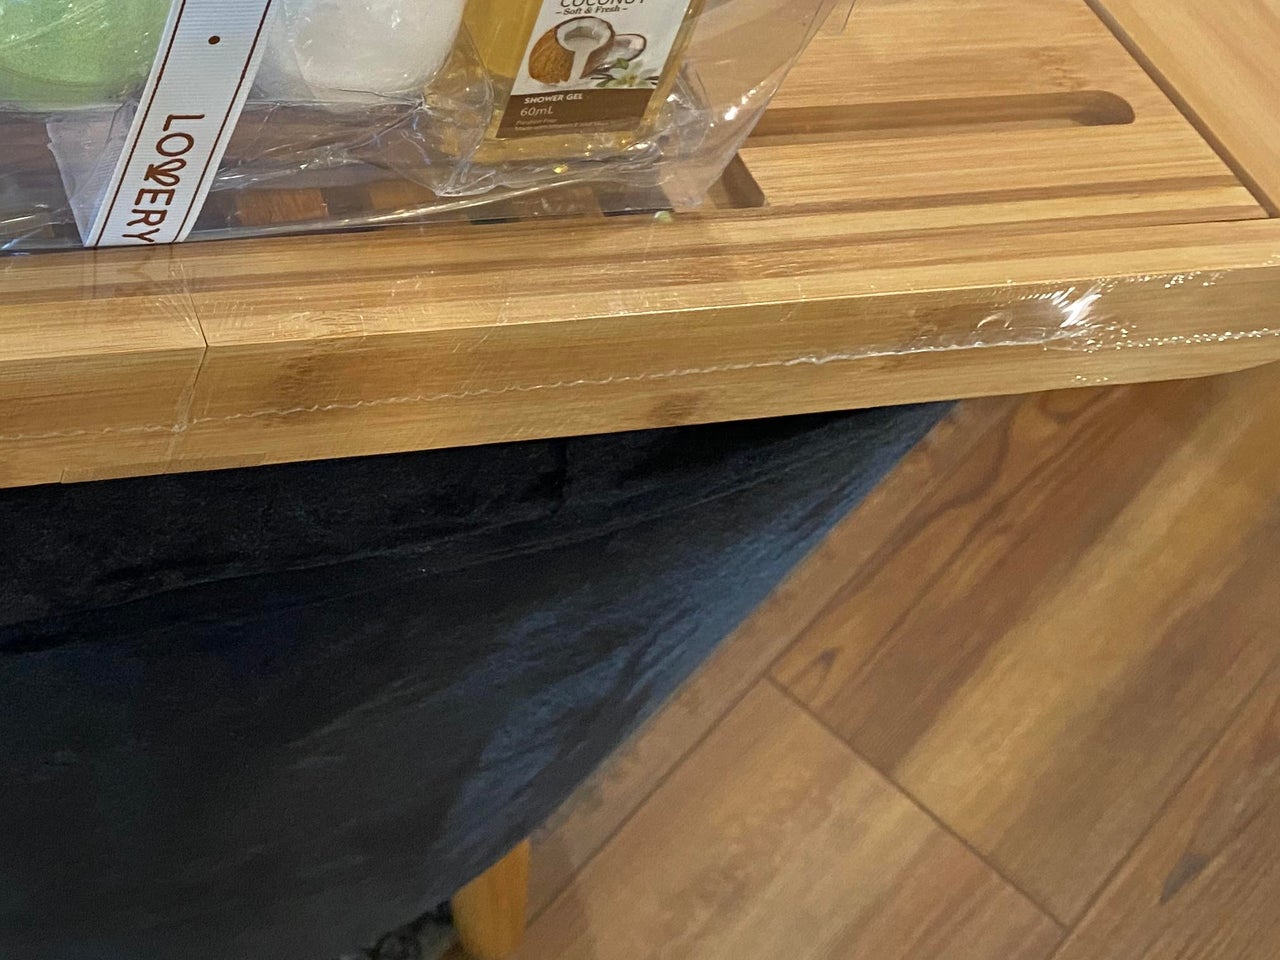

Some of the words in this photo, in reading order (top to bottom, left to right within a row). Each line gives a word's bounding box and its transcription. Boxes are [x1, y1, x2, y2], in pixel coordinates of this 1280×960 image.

[524, 94, 564, 104] SHOWER
[566, 91, 584, 101] GEL
[520, 105, 554, 117] 60mL
[121, 113, 206, 243] LOVERY
